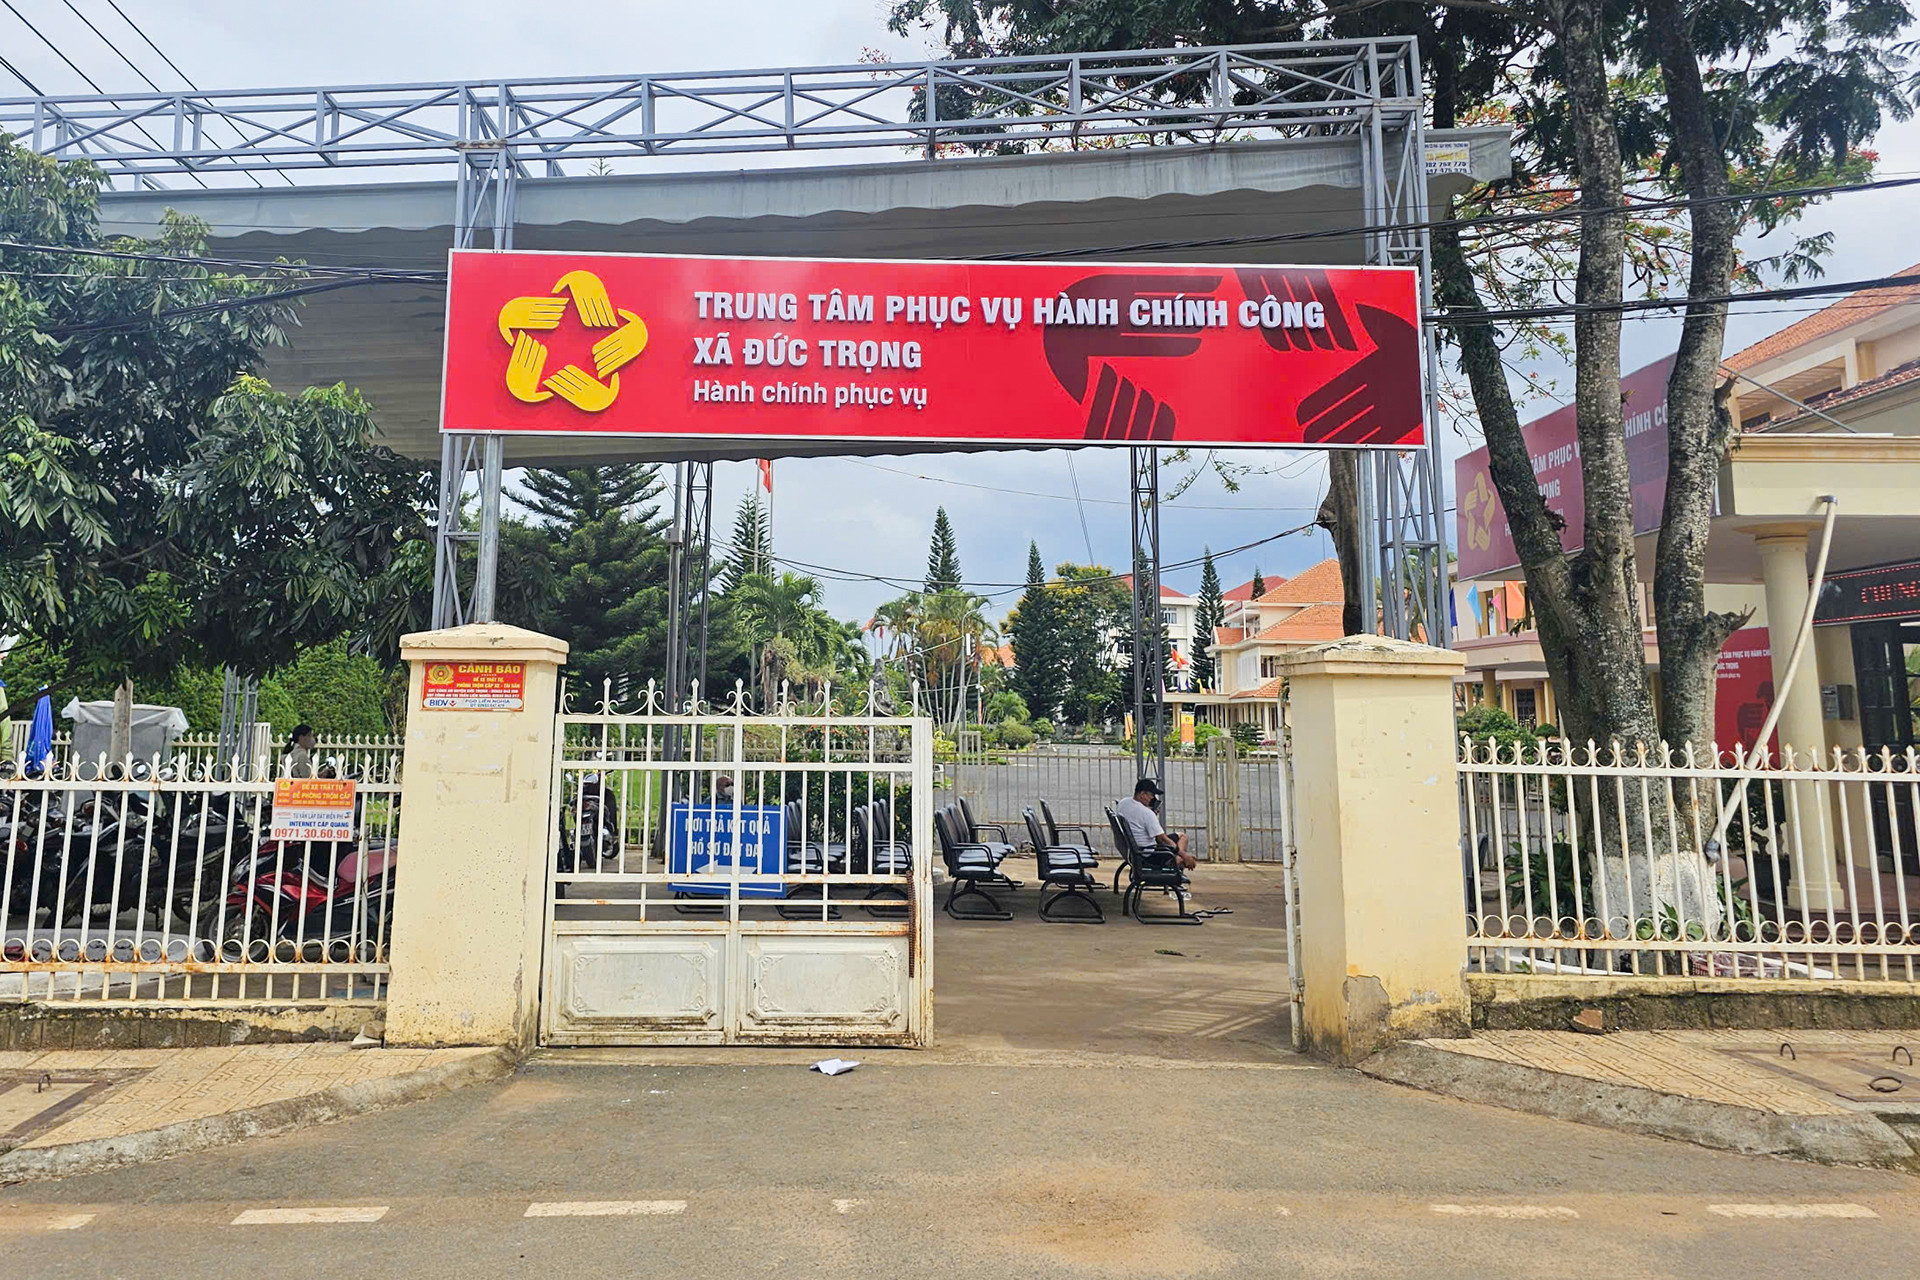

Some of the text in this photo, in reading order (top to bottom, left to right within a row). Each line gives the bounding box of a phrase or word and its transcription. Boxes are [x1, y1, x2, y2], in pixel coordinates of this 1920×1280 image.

[694, 289, 1326, 331] TRUNG TÂM PHỤC VỤ HÀNH CHÍNH CÔNG
[692, 332, 922, 374] XÃ ĐỨC TRỌNG
[693, 380, 928, 411] Hành chính phục vụ
[1548, 443, 1573, 468] PHỤC
[1625, 410, 1652, 439] HÍNH
[1654, 398, 1668, 427] CÔ
[1537, 478, 1561, 504] RỌNG
[458, 663, 492, 673] CẢNH
[274, 828, 350, 839] 0971.30.60.90
[705, 814, 724, 833] TẢ
[727, 818, 747, 834] KT
[746, 843, 764, 858] ĐA
